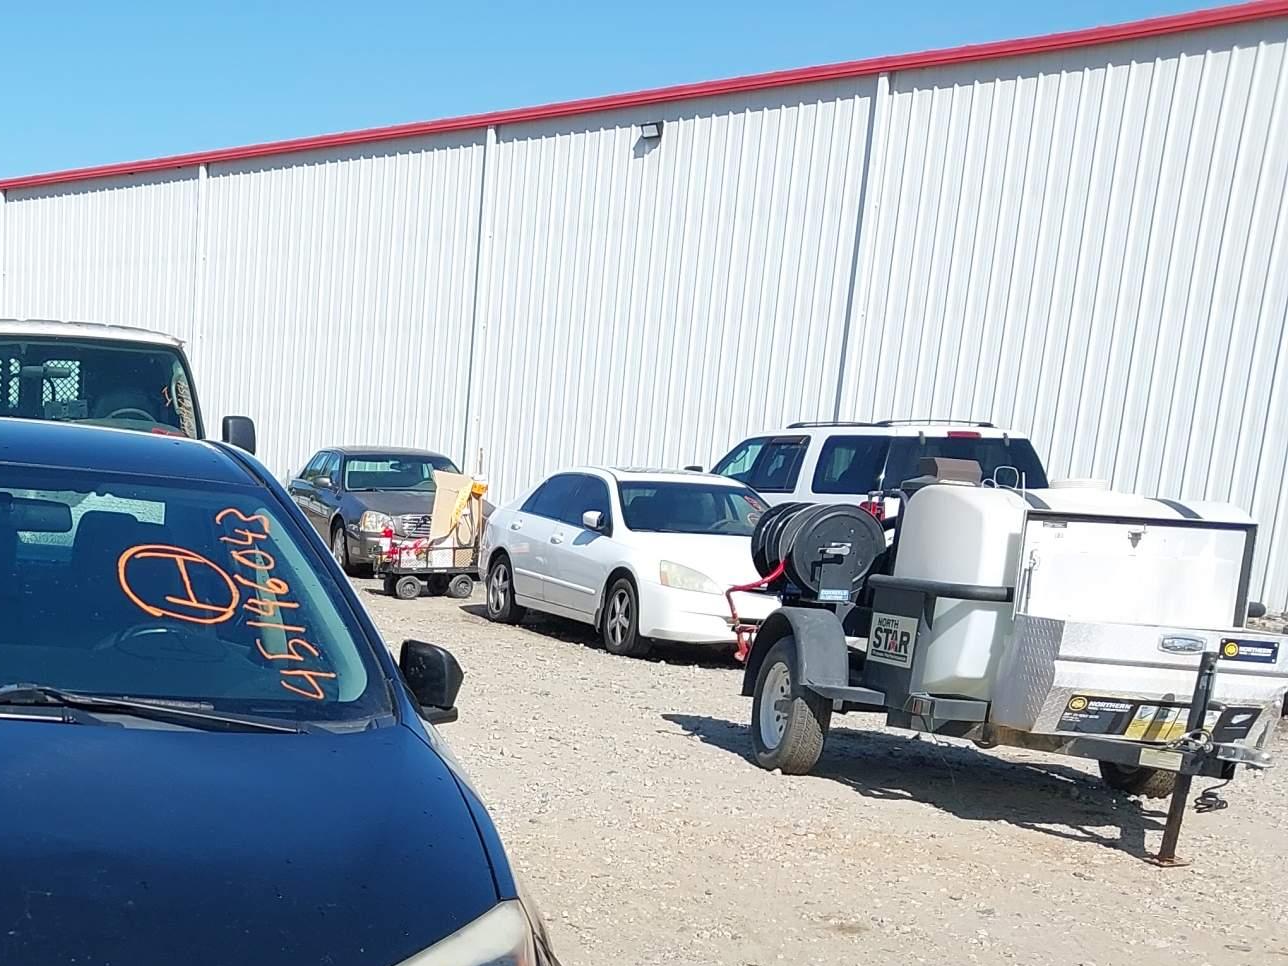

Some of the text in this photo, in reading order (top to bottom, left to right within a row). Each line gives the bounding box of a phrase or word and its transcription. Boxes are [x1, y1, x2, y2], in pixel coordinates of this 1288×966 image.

[215, 507, 337, 699] 45146043
[877, 617, 900, 629] NORTH
[872, 626, 911, 655] STAR
